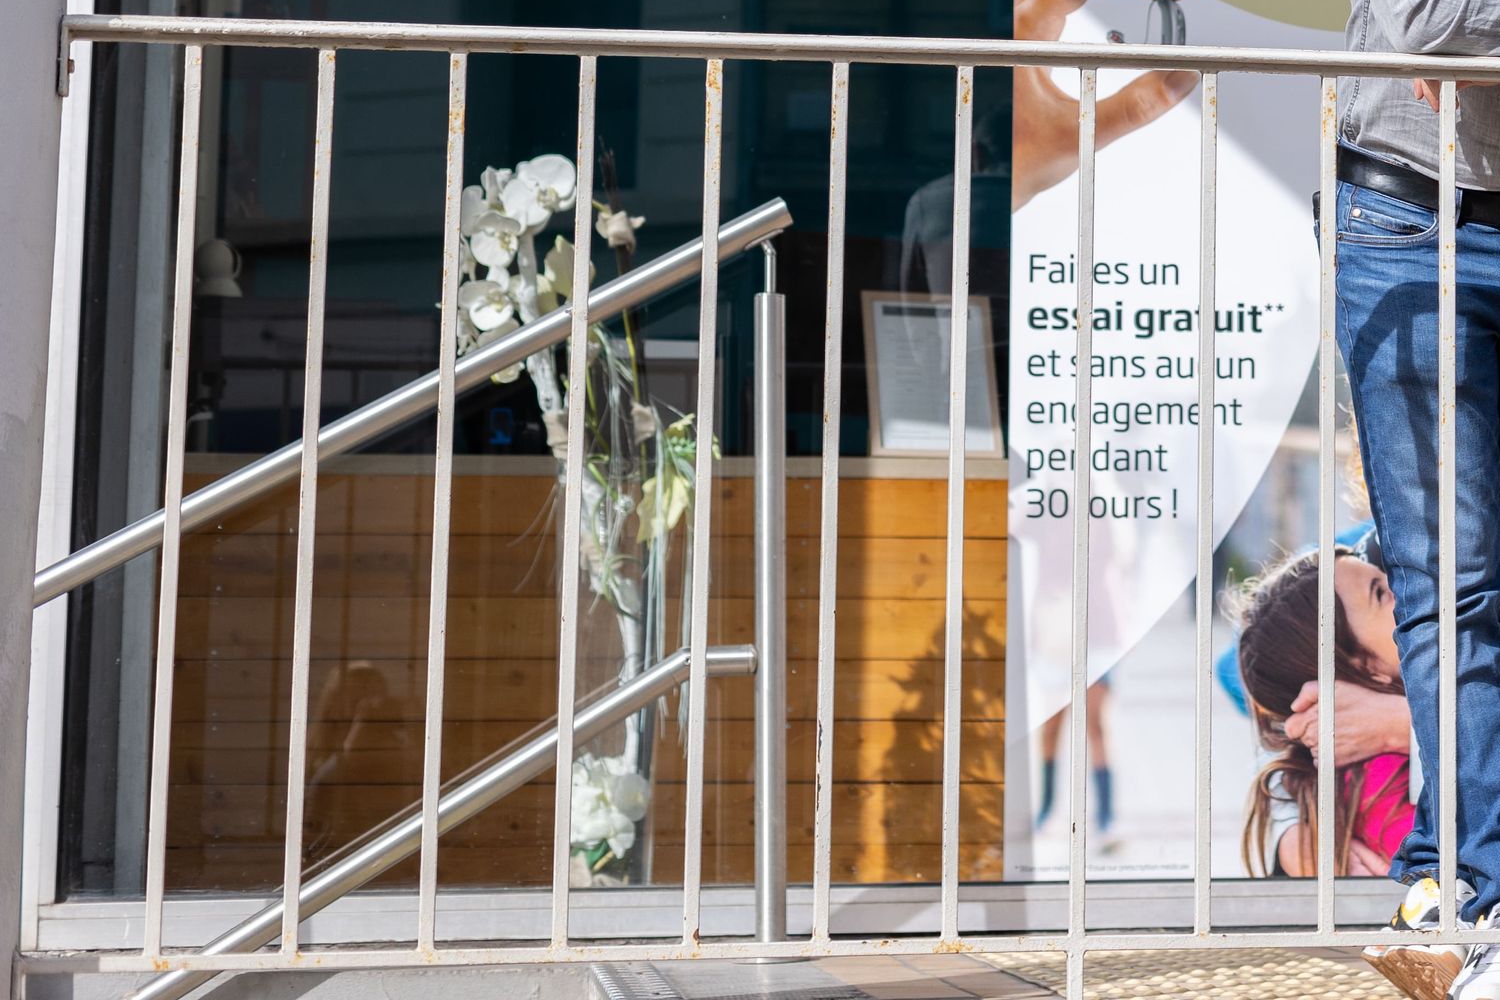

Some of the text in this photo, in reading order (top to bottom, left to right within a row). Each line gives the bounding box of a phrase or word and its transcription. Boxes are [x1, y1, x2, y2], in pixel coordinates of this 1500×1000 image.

[1029, 253, 1180, 286] Faies un
[1133, 302, 1285, 339] grauit
[1027, 349, 1061, 377] et
[1156, 356, 1255, 379] auun
[1027, 440, 1168, 479] pedant
[1026, 488, 1069, 519] 30
[1088, 496, 1162, 519] ours
